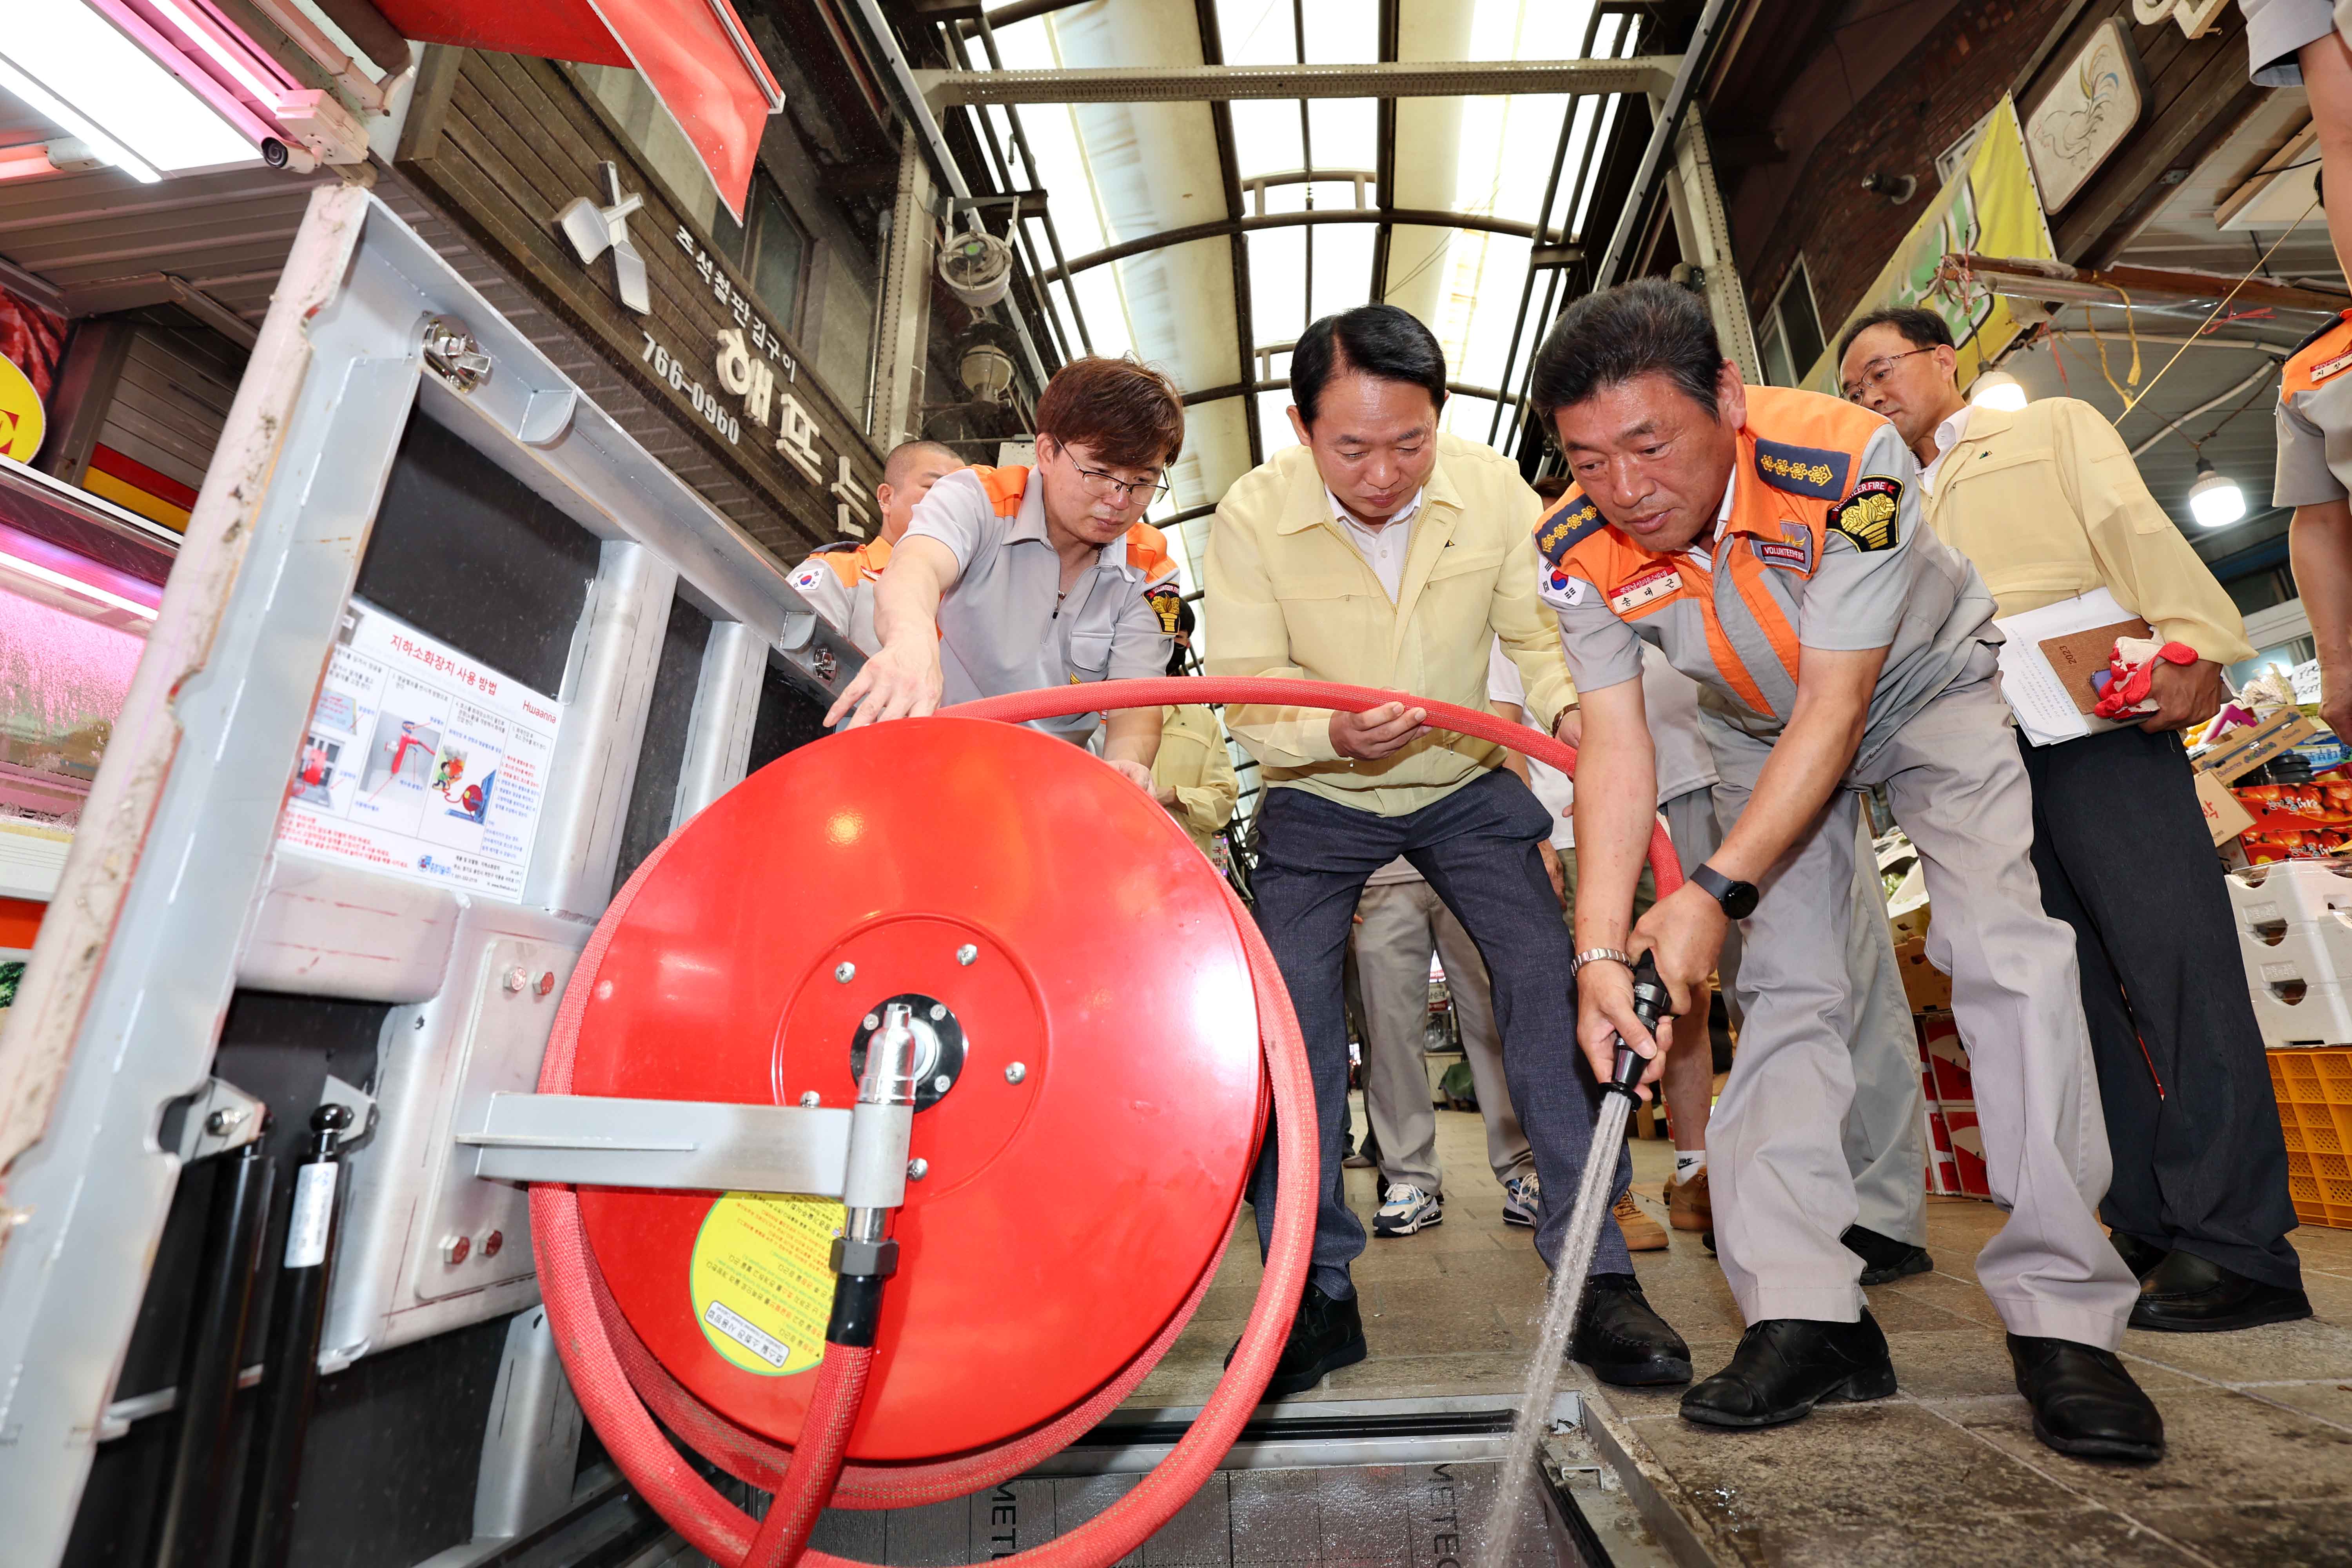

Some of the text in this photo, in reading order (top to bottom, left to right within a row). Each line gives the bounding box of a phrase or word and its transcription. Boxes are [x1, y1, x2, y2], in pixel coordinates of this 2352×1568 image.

[642, 331, 740, 445] 766-0960
[1868, 482, 1886, 490] FIRE
[388, 633, 498, 697] 지하소화장치 사용 방법
[2060, 645, 2077, 665] 2023
[522, 699, 557, 724] Hwaanna
[990, 1481, 1020, 1562] MET
